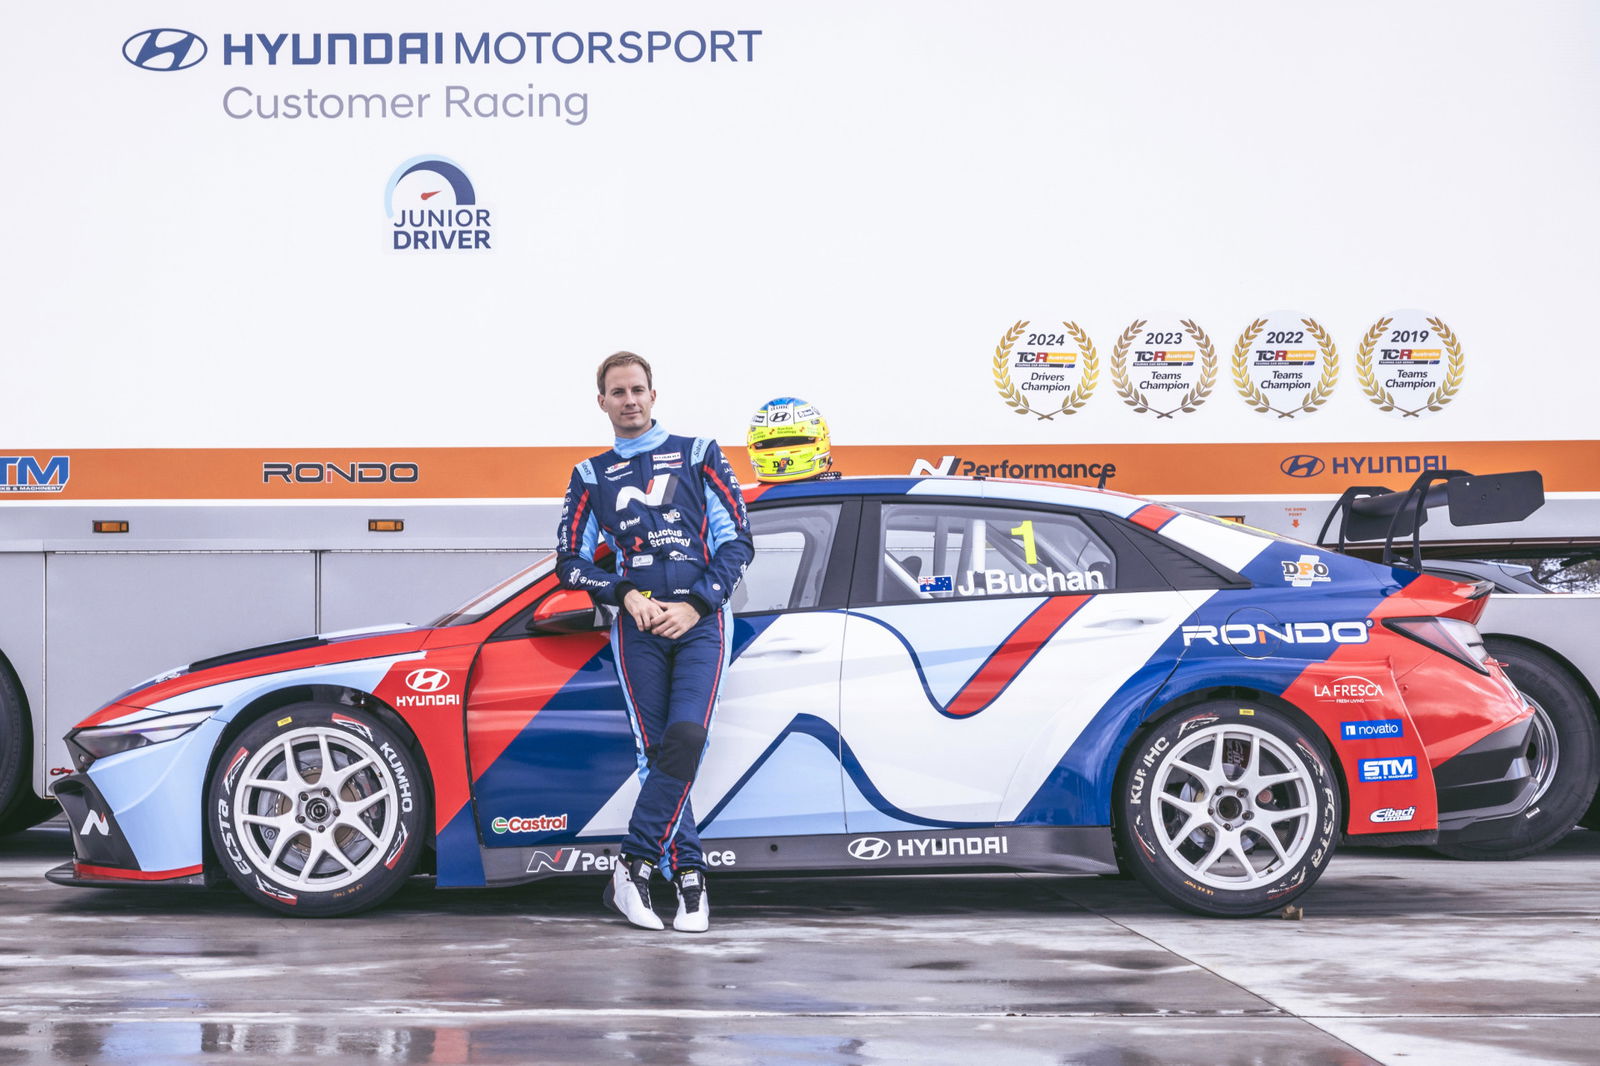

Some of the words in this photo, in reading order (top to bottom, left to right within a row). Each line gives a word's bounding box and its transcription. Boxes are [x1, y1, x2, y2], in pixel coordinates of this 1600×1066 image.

[223, 33, 443, 66] HYUNDAI
[455, 29, 763, 64] MOTORSPORT
[222, 85, 431, 120] Customer
[444, 83, 589, 126] Racing
[393, 208, 492, 228] JUNIOR
[393, 230, 492, 250] DRIVER
[1027, 333, 1065, 346] 2024
[1145, 332, 1183, 345] 2023
[1266, 331, 1304, 344] 2022
[1391, 330, 1429, 343] 2019
[1017, 352, 1048, 362] TCR
[1134, 350, 1166, 361] TCR
[1256, 350, 1287, 361] TCR
[1381, 349, 1412, 360] TCR
[1030, 372, 1064, 382] Drivers
[1151, 371, 1181, 380] Teams
[1272, 370, 1303, 379] Teams
[1397, 369, 1428, 378] Teams
[1021, 382, 1070, 393] Champion
[1139, 380, 1189, 392] Champion
[1260, 380, 1311, 391] Champion
[1385, 379, 1436, 390] Champion
[963, 460, 1116, 479] Performance
[1332, 455, 1447, 475] HYUNDAI
[262, 462, 419, 484] RONDO
[1010, 520, 1037, 565] 1
[1282, 562, 1328, 576] DPO
[957, 567, 1104, 596] J.Buchan
[1314, 685, 1331, 697] LA
[1333, 684, 1384, 697] FRESCA
[396, 694, 460, 707] HYUNDAI
[1358, 723, 1399, 735] novatio
[1363, 758, 1413, 776] STM
[380, 742, 413, 813] KUMHO
[1370, 806, 1416, 822] Eibach
[508, 814, 568, 833] Castrol
[897, 836, 1008, 857] HYUNDAI
